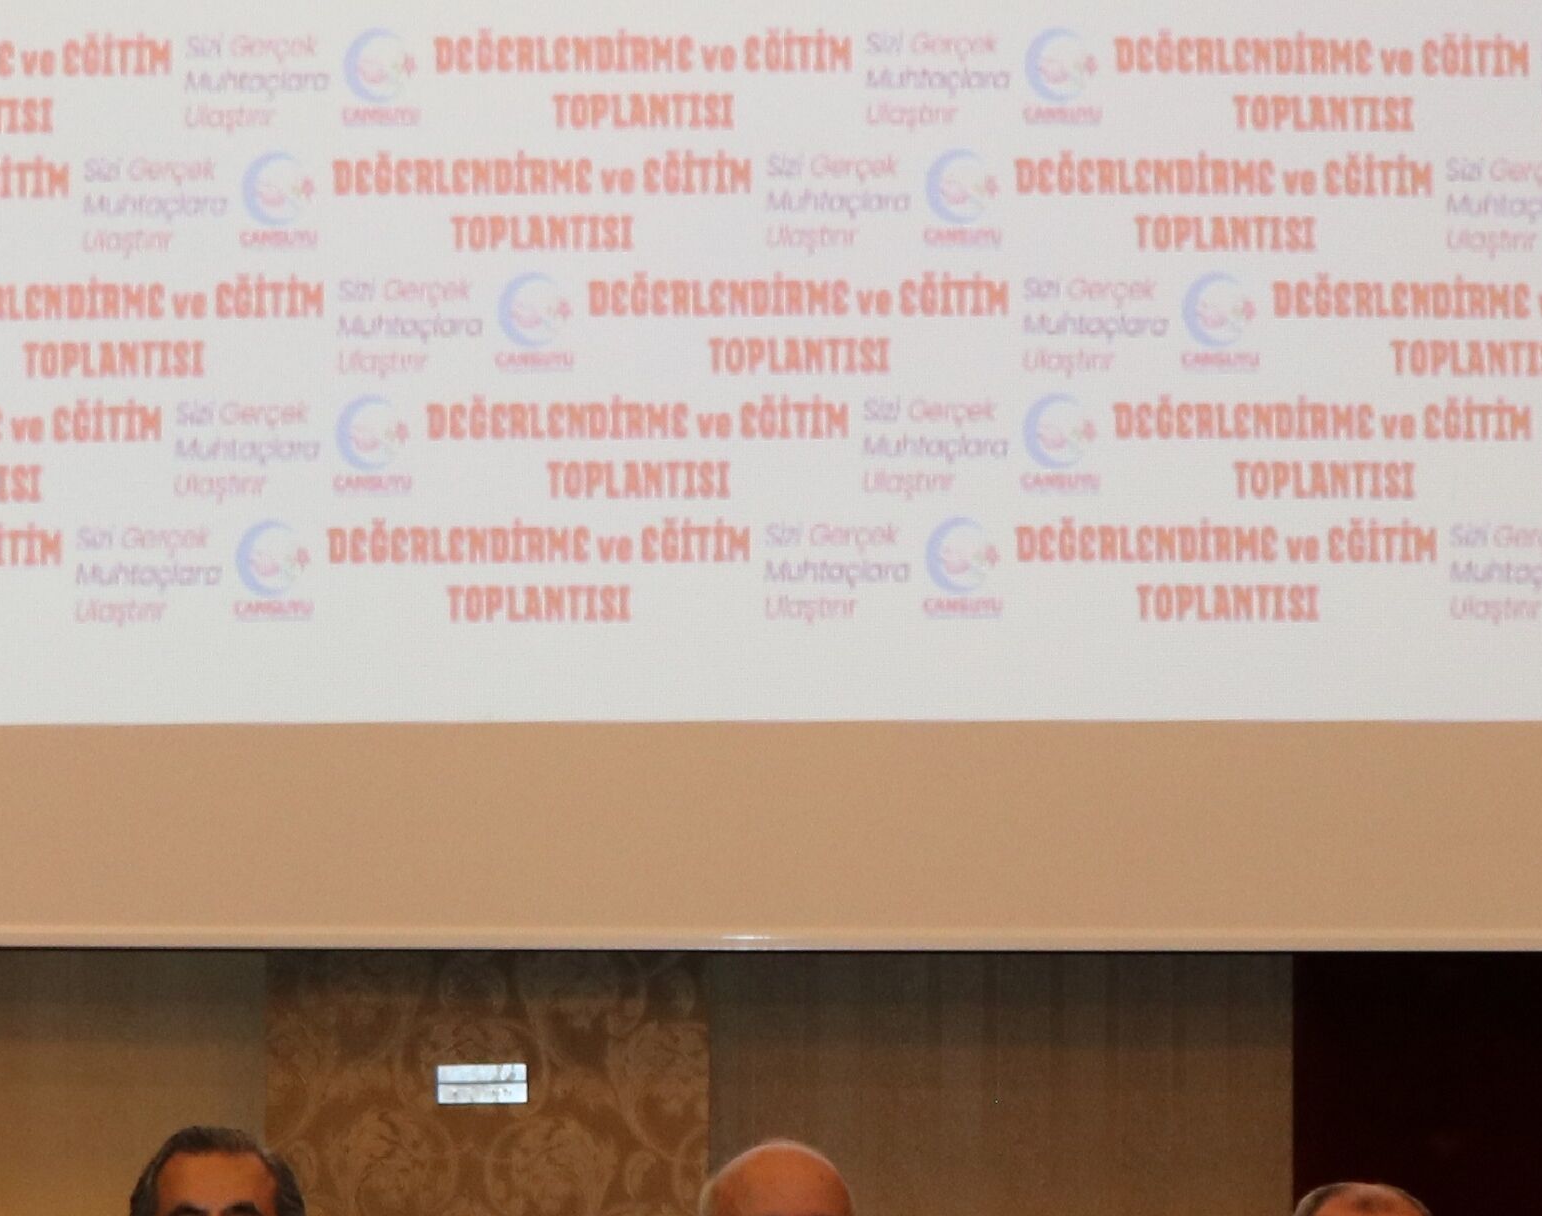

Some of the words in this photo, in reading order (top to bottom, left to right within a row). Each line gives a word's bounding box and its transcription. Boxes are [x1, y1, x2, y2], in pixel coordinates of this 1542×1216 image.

[21, 50, 56, 76] ve
[700, 44, 737, 72] ve
[1380, 48, 1415, 75] ve
[552, 91, 734, 129] TOPLANTISI
[1233, 93, 1413, 132] TOPLANTISI
[599, 167, 637, 194] ve
[1282, 169, 1318, 196] ve
[451, 213, 633, 251] TOPLANTISI
[1135, 214, 1315, 251] TOPLANTISI
[171, 292, 207, 319] ve
[856, 289, 893, 316] ve
[23, 340, 204, 378] TOPLANTISI
[709, 337, 890, 374] TOPLANTISI
[10, 416, 44, 443] ve
[696, 412, 733, 439] ve
[1381, 413, 1417, 440] ve
[547, 460, 729, 498] TOPLANTISI
[1234, 460, 1415, 498] TOPLANTISI
[596, 535, 633, 563] ve
[1286, 536, 1321, 562] ve
[448, 584, 631, 622] TOPLANTISI
[1137, 583, 1319, 621] TOPLANTISI
